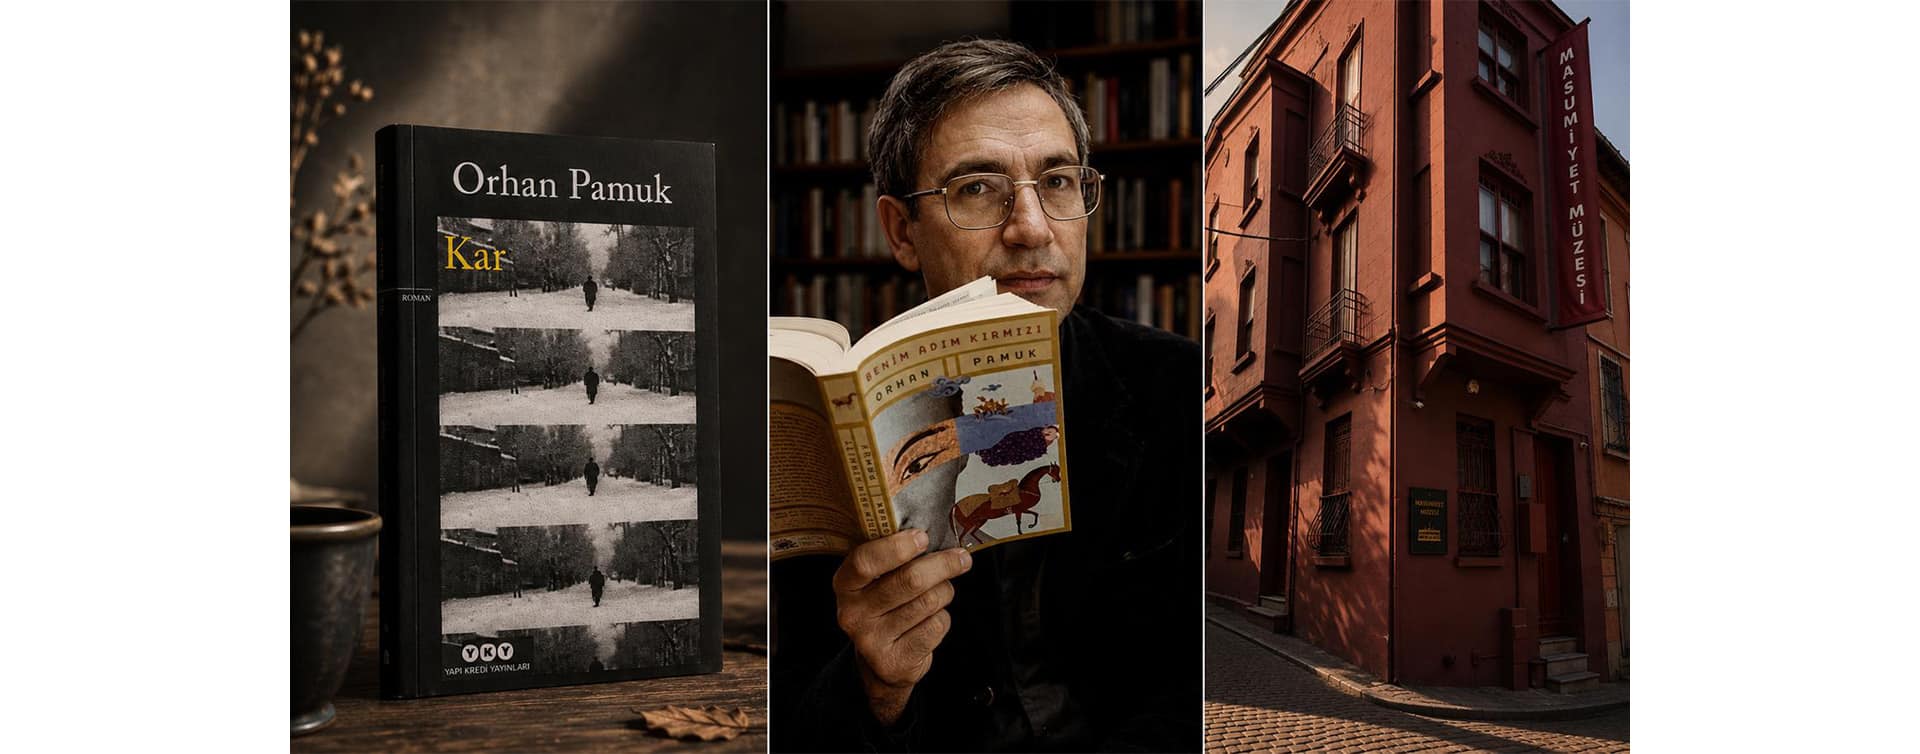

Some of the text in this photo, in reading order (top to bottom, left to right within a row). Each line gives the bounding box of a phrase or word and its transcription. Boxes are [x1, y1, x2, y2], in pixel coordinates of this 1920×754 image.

[452, 161, 672, 204] Orhan Pamuk
[1559, 47, 1586, 305] MASUMİYET MÜZESİ
[444, 235, 506, 272] Kar
[402, 294, 431, 302] ROMAN
[865, 325, 1042, 382] BENİM ADIM KIRMIZI
[875, 349, 1037, 401] ORHAN PAMUK
[463, 643, 512, 661] YKY
[464, 664, 488, 674] KREDİ
[490, 663, 530, 673] YAYINLARI
